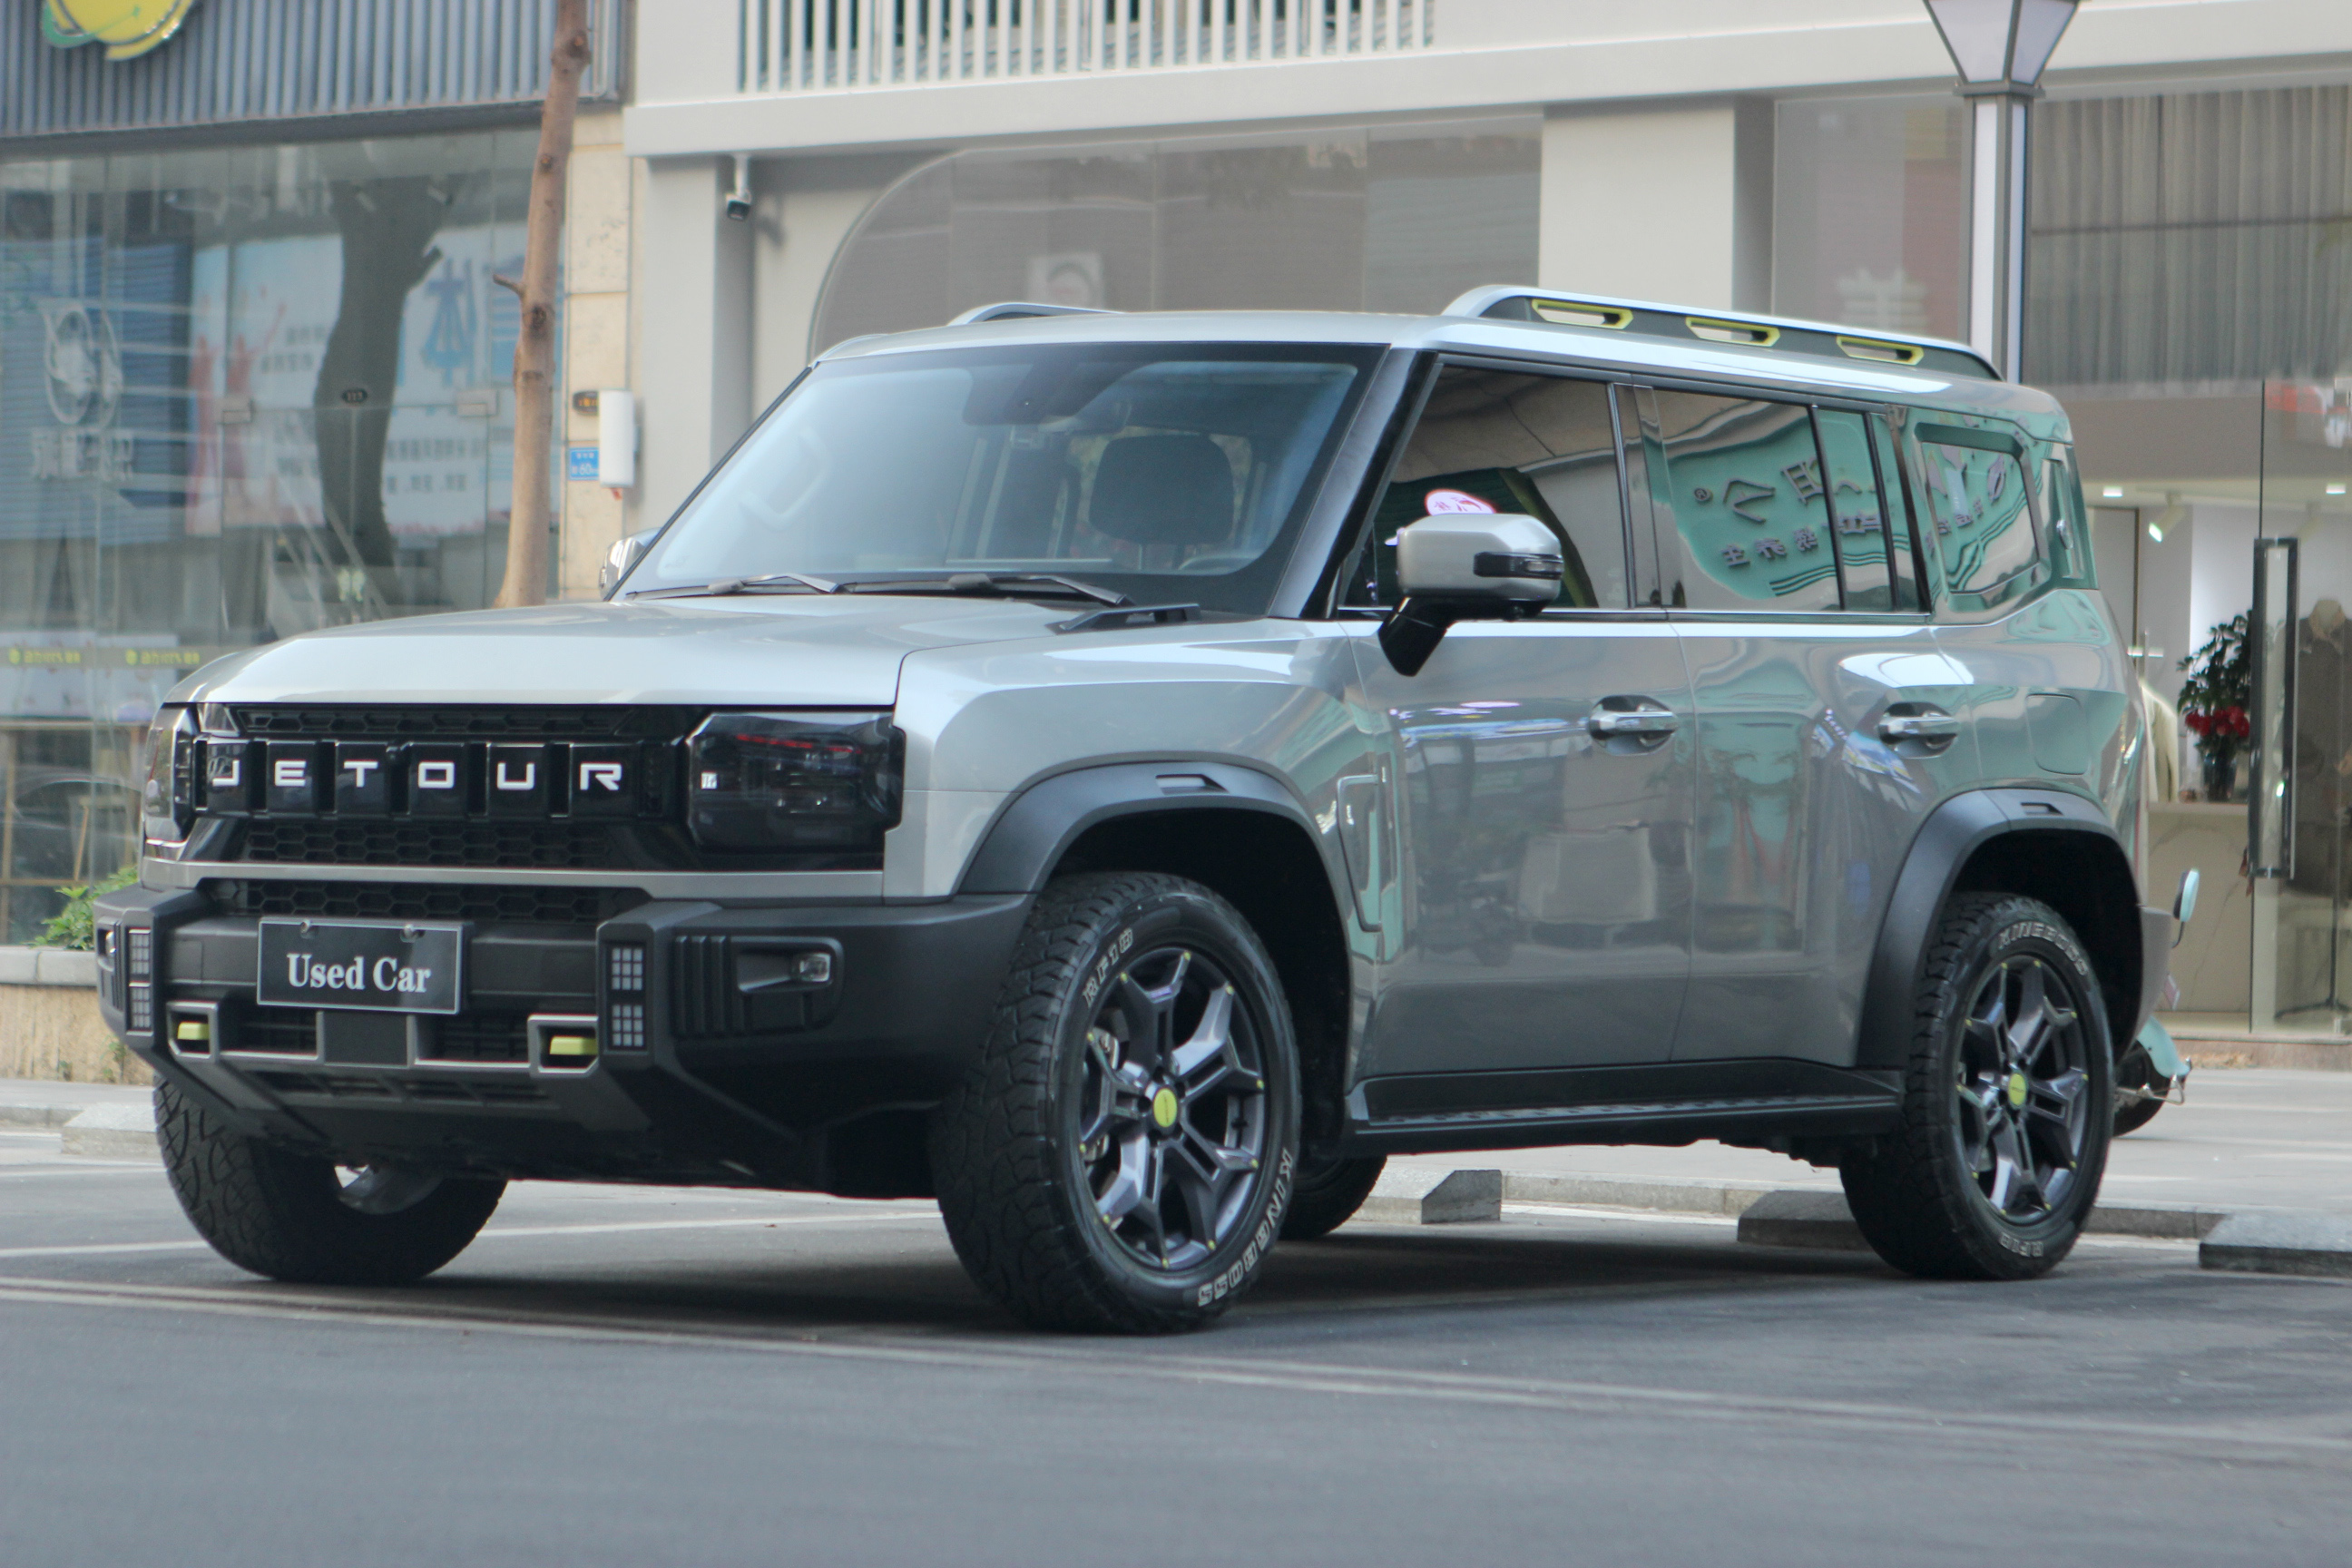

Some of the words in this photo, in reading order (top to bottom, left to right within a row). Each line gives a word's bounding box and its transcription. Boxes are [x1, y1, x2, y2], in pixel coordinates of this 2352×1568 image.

[212, 759, 622, 791] JETOUR
[286, 953, 366, 990] Used
[372, 956, 432, 993] Car
[1198, 1147, 1293, 1307] KINGBOSS
